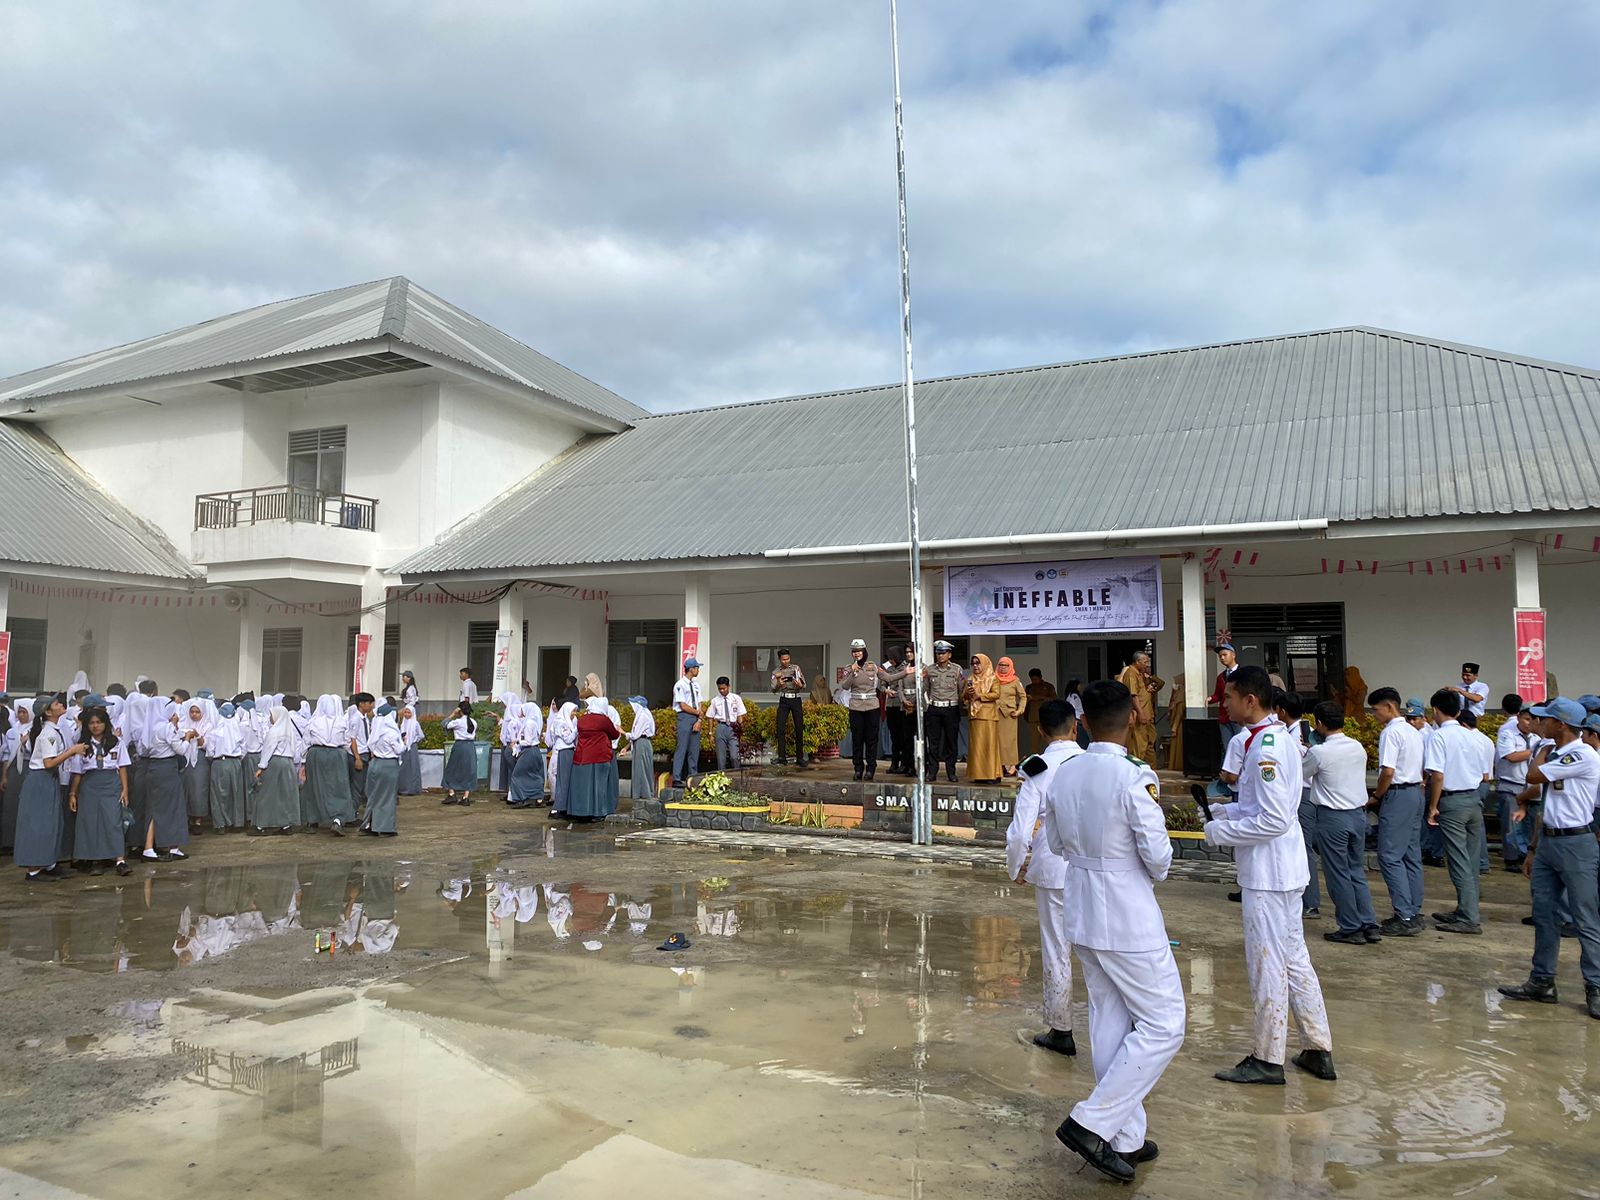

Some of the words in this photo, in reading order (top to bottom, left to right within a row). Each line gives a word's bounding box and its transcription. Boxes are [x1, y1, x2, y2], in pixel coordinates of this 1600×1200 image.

[994, 588, 1111, 609] INEFFABLE
[875, 795, 913, 807] SMA
[937, 798, 1009, 813] MAMUJU
